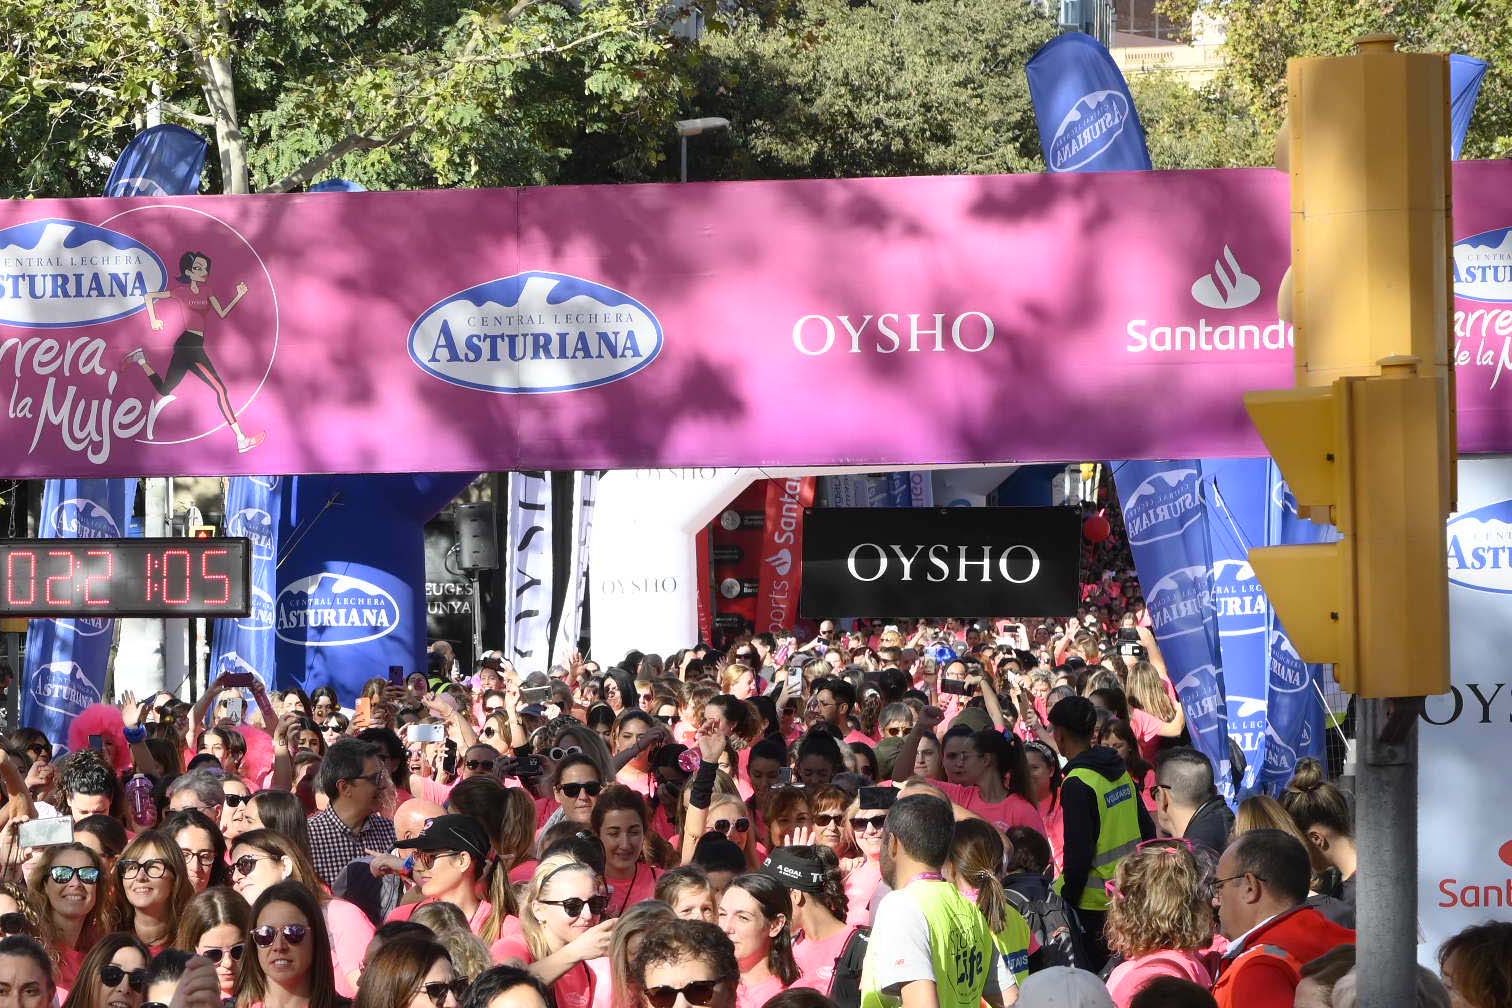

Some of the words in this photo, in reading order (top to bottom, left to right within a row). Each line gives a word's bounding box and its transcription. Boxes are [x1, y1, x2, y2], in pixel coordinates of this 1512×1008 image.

[70, 255, 143, 266] LECHERA
[467, 314, 545, 328] CENTRAL
[553, 312, 635, 325] LECHERA
[791, 311, 997, 356] OYSHO
[427, 318, 643, 364] ASTURIANA
[1476, 339, 1495, 367] la
[8, 379, 34, 418] la
[28, 370, 177, 465] Mujer
[847, 542, 1041, 585] OYSHO
[601, 576, 678, 595] OYSHO
[336, 597, 386, 607] LECHERA
[277, 603, 391, 630] ASTURIANA
[955, 945, 983, 989] Life
